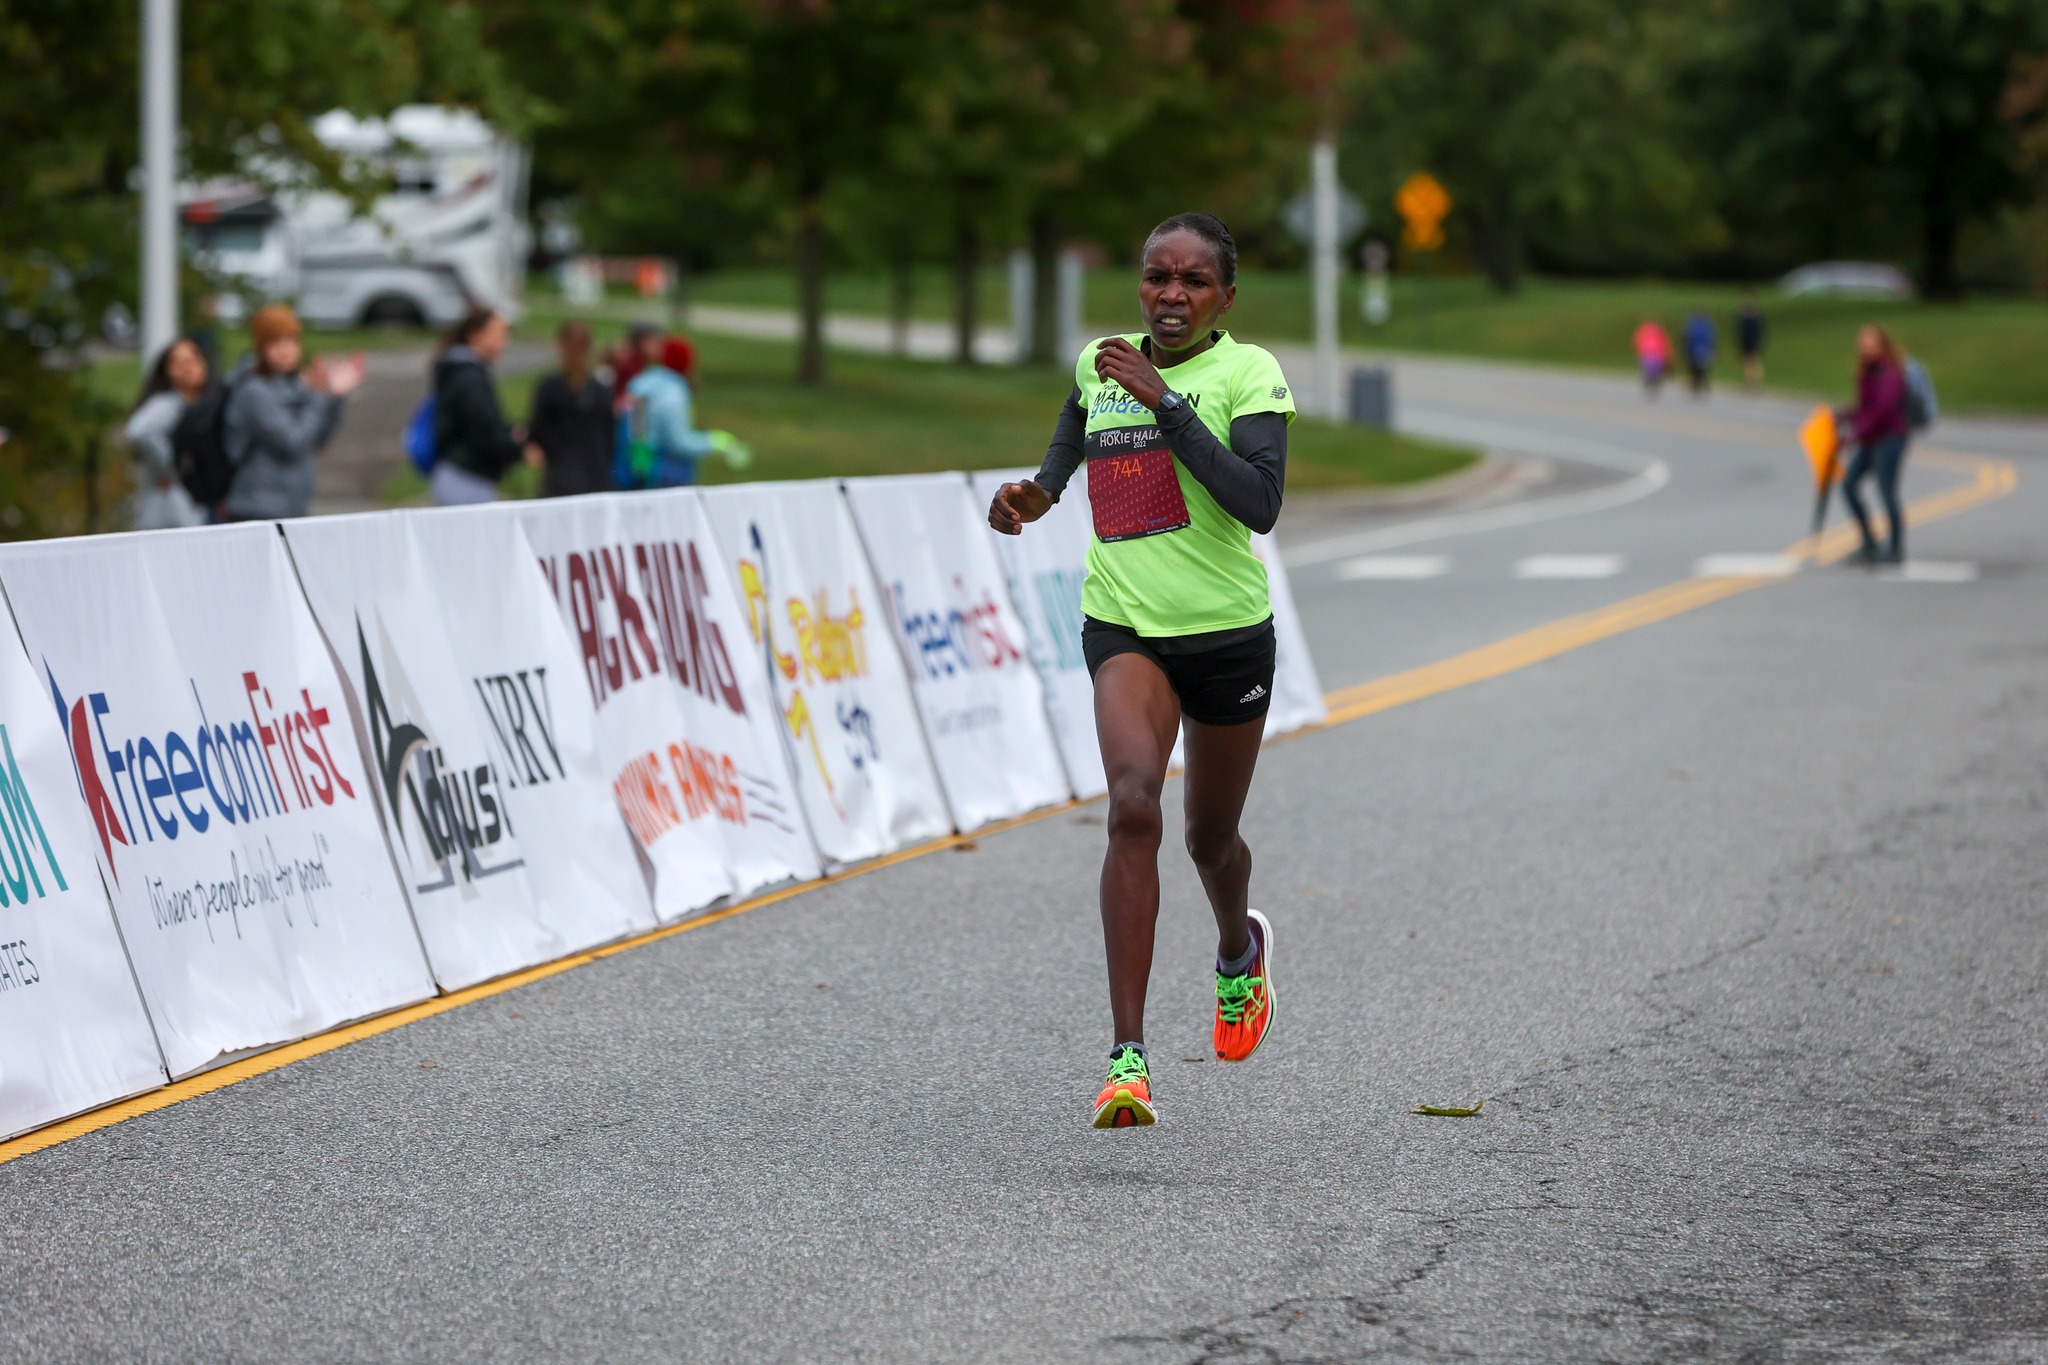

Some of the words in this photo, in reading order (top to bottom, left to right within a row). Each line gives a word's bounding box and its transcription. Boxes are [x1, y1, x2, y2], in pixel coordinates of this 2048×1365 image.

[1100, 432, 1130, 447] HOKIE
[1133, 429, 1161, 442] HALF
[1111, 458, 1143, 481] 744
[1240, 689, 1267, 703] adidas
[88, 671, 356, 843] FreedomFirst
[474, 667, 566, 789] NRV
[145, 874, 198, 931] Where
[195, 850, 254, 944] people
